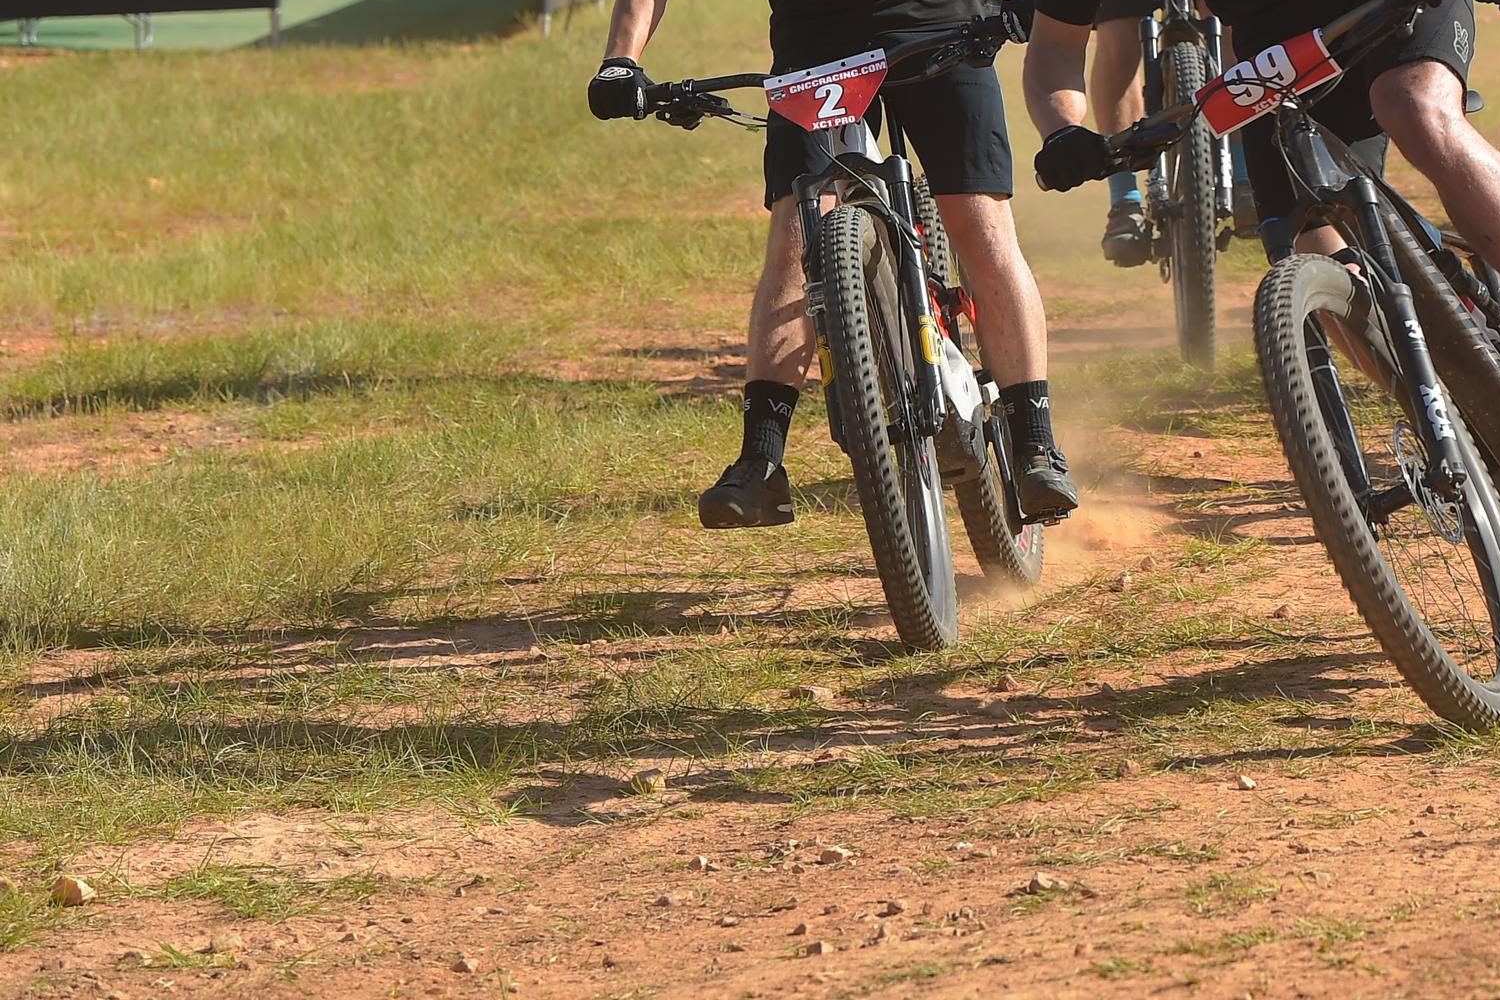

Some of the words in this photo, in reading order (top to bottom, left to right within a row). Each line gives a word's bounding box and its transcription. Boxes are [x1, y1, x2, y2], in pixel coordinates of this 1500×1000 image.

[789, 61, 887, 95] GNCCRACING.COM
[1223, 44, 1298, 107] 99
[814, 83, 847, 120] 2
[812, 119, 834, 131] XC1
[834, 115, 856, 127] PRO
[1419, 383, 1457, 441] FOX
